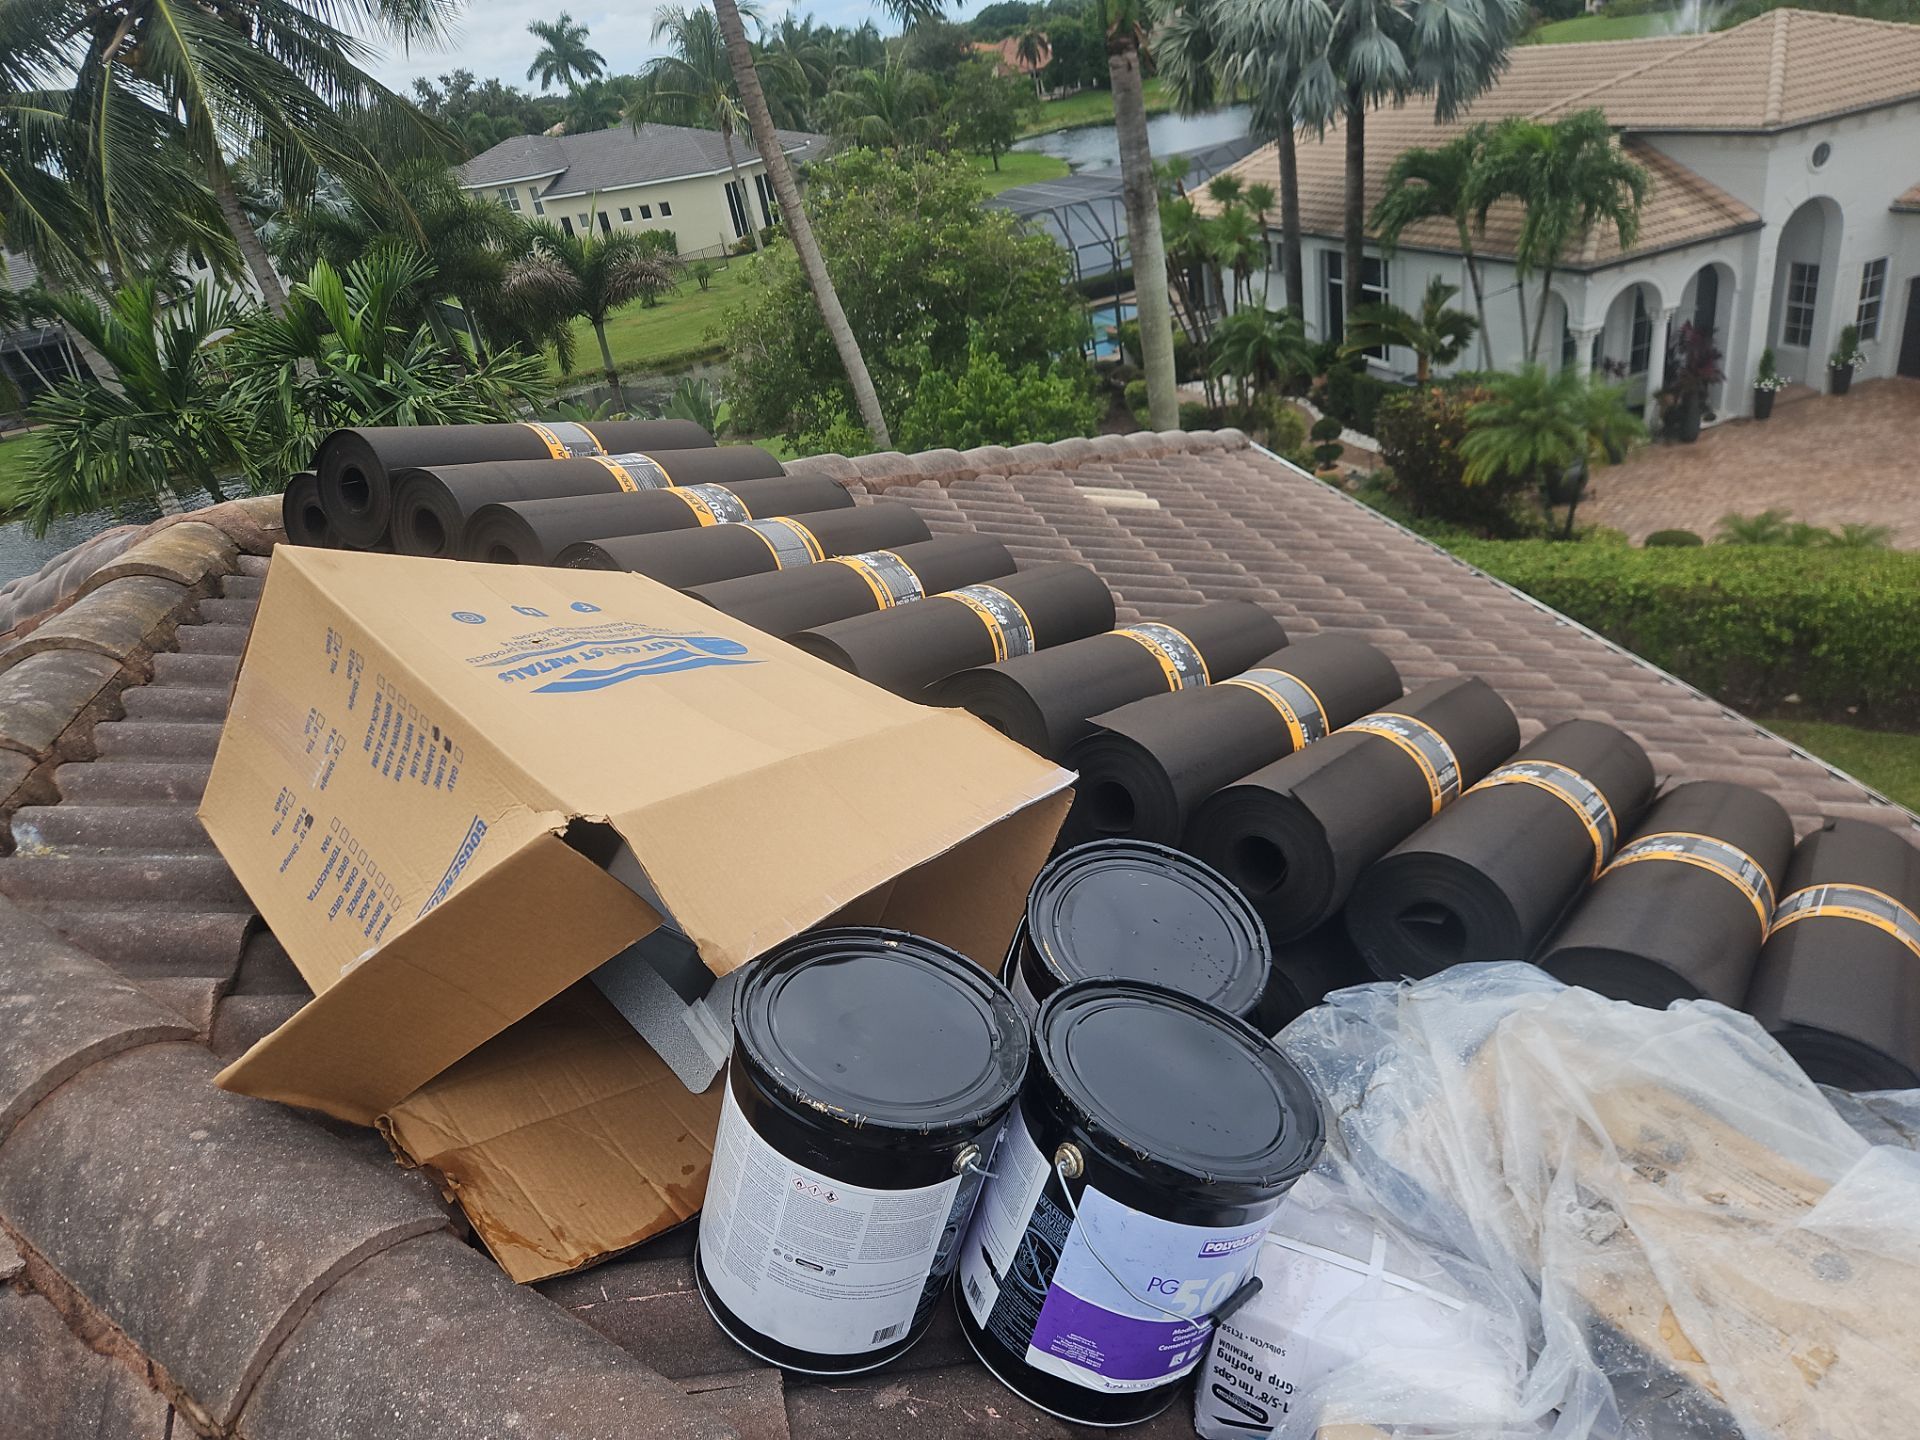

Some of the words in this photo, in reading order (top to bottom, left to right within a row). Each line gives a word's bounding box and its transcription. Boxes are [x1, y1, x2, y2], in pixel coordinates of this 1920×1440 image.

[579, 646, 640, 661] COAST
[498, 655, 579, 683] METALS
[371, 692, 382, 725] BLACK
[380, 702, 392, 741] BRONZE
[363, 723, 376, 752] ALUM
[391, 712, 403, 748] BROWN
[401, 723, 414, 753] WHITE
[371, 739, 384, 769] ALUM
[382, 746, 396, 777] ALUM
[394, 752, 407, 782] ALUM
[409, 748, 422, 778] ALUM
[421, 743, 436, 785] DAMPER
[320, 760, 335, 792] Shingle
[447, 765, 459, 792] GALV
[280, 843, 299, 873] Shingle
[321, 834, 332, 854] TAN
[307, 845, 341, 901] TERRACOTTA
[336, 855, 350, 882] GREY
[328, 895, 344, 921] GREY
[346, 878, 367, 917] BRONZE
[358, 889, 376, 922] BLACK
[364, 901, 384, 937] BROWN
[1221, 1323, 1244, 1340] TC158
[1250, 1336, 1287, 1357] 50lbs/Ctn
[1216, 1347, 1263, 1382] Roofing
[1218, 1338, 1254, 1362] PREMIUM
[1213, 1365, 1237, 1386] Caps
[1238, 1380, 1254, 1397] Tin
